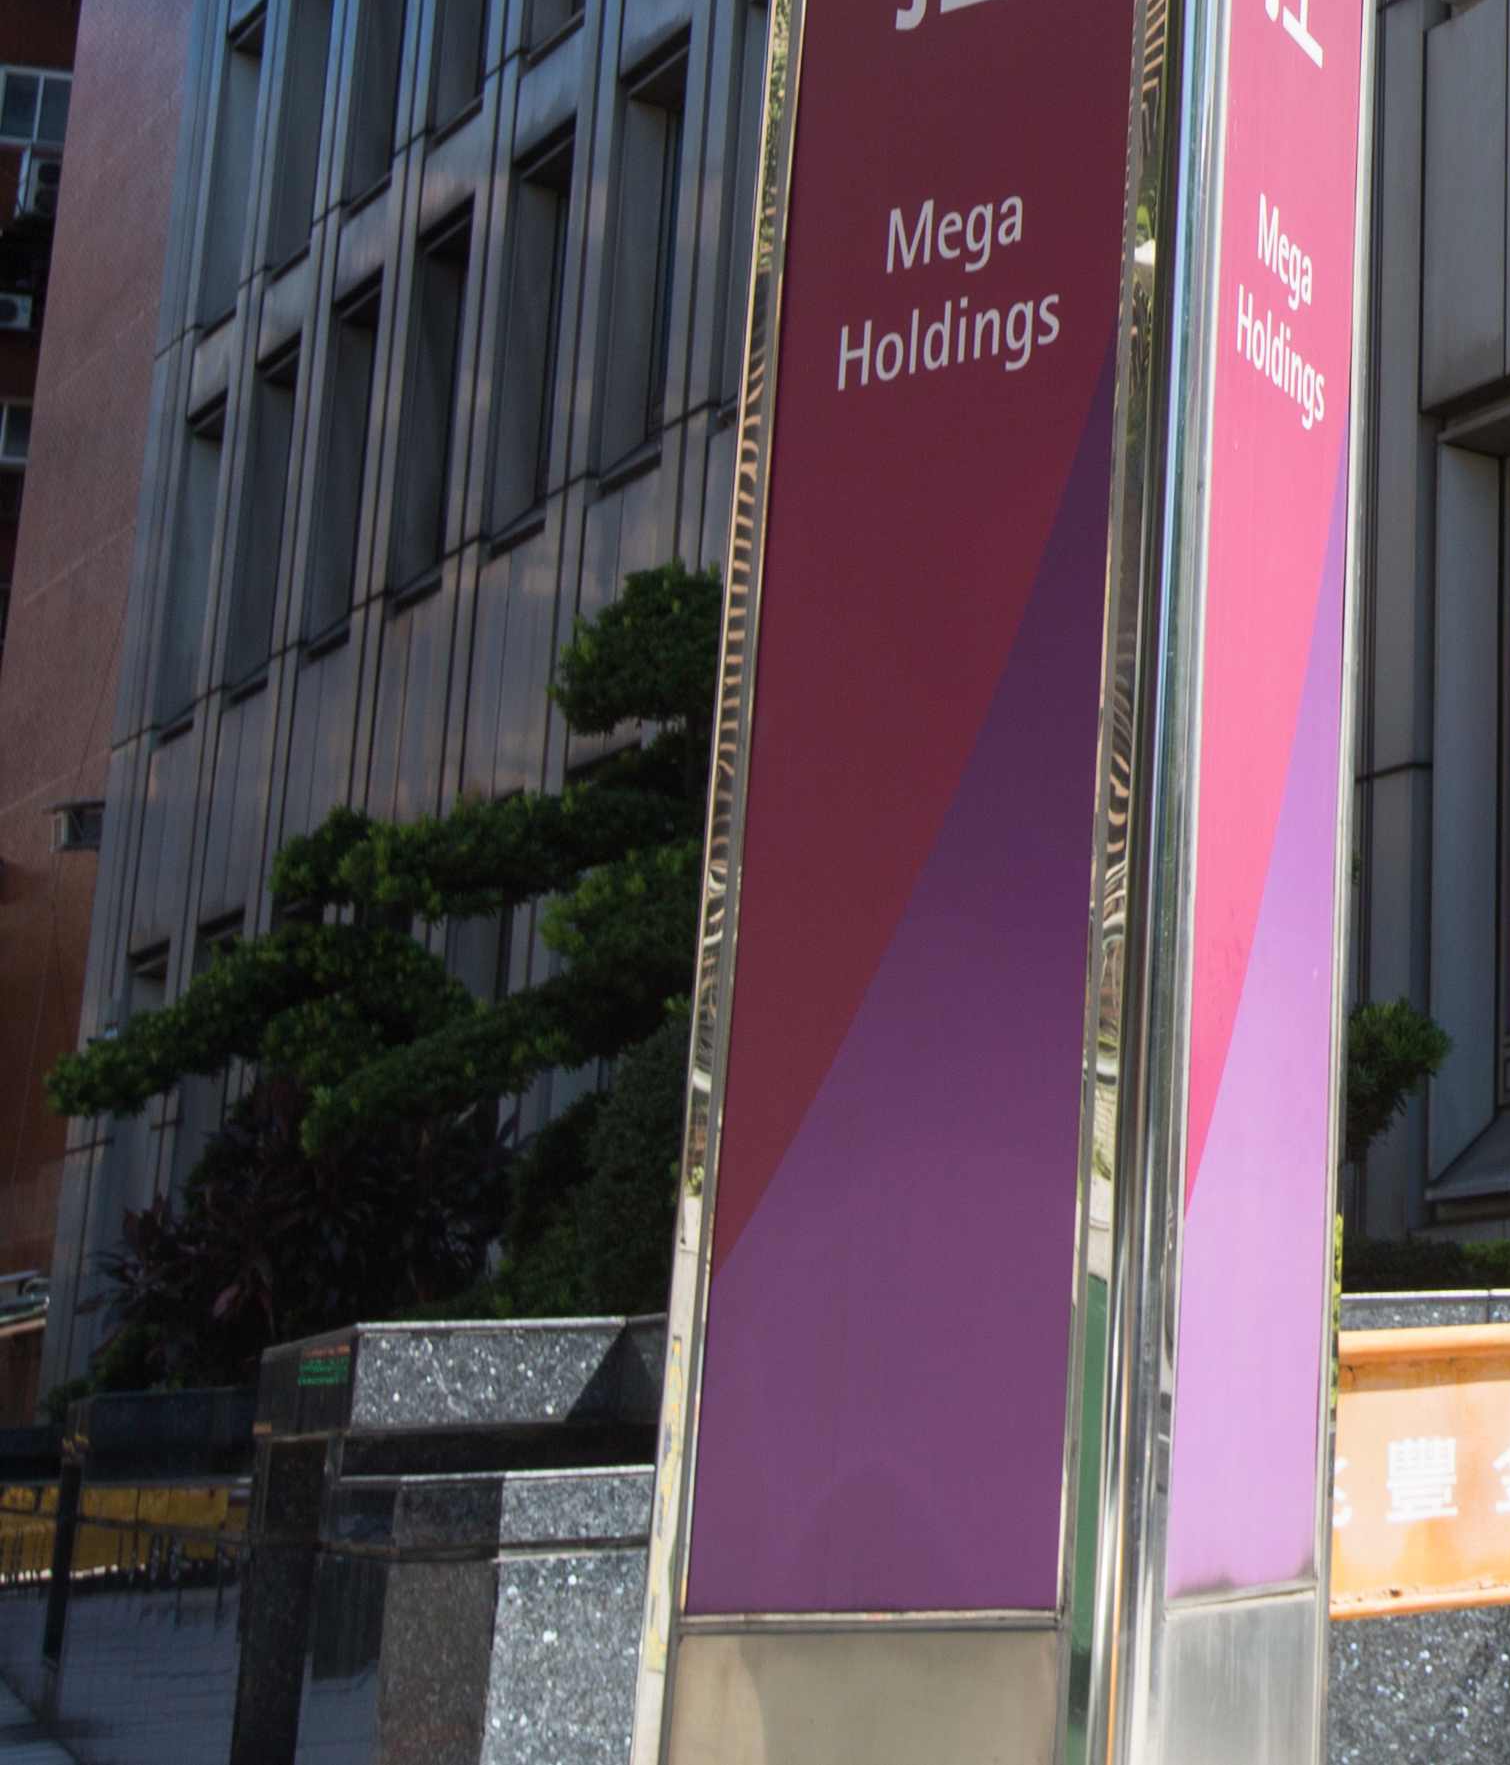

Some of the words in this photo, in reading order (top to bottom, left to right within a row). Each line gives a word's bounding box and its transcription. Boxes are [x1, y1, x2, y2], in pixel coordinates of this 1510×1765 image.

[885, 195, 1025, 274] Mega
[1257, 192, 1314, 311] Mega
[837, 293, 1062, 391] Holdings
[1236, 283, 1326, 431] Holdings
